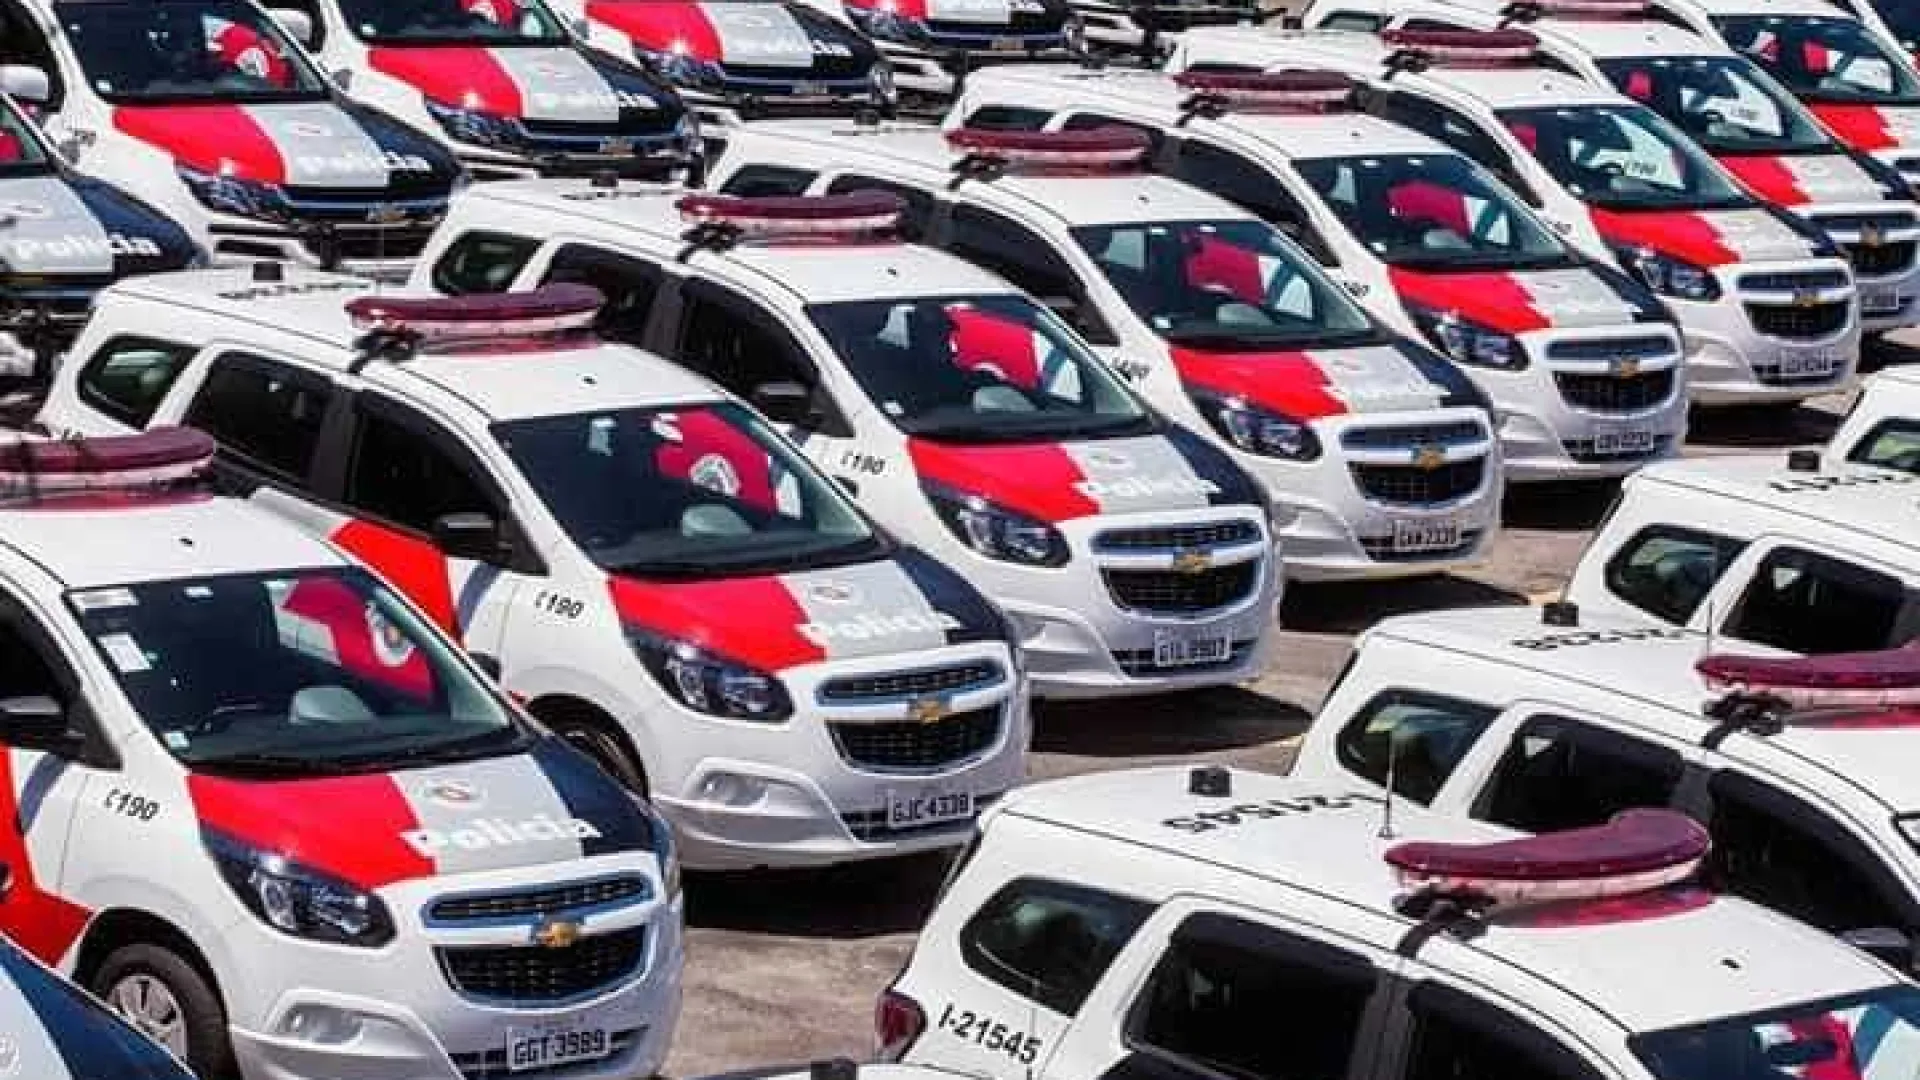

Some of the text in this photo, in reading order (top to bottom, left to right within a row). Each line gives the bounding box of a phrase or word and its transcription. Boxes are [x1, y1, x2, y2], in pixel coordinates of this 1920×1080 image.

[547, 592, 585, 619] 190
[117, 791, 161, 821] 190
[938, 1003, 1043, 1064] I-21545
